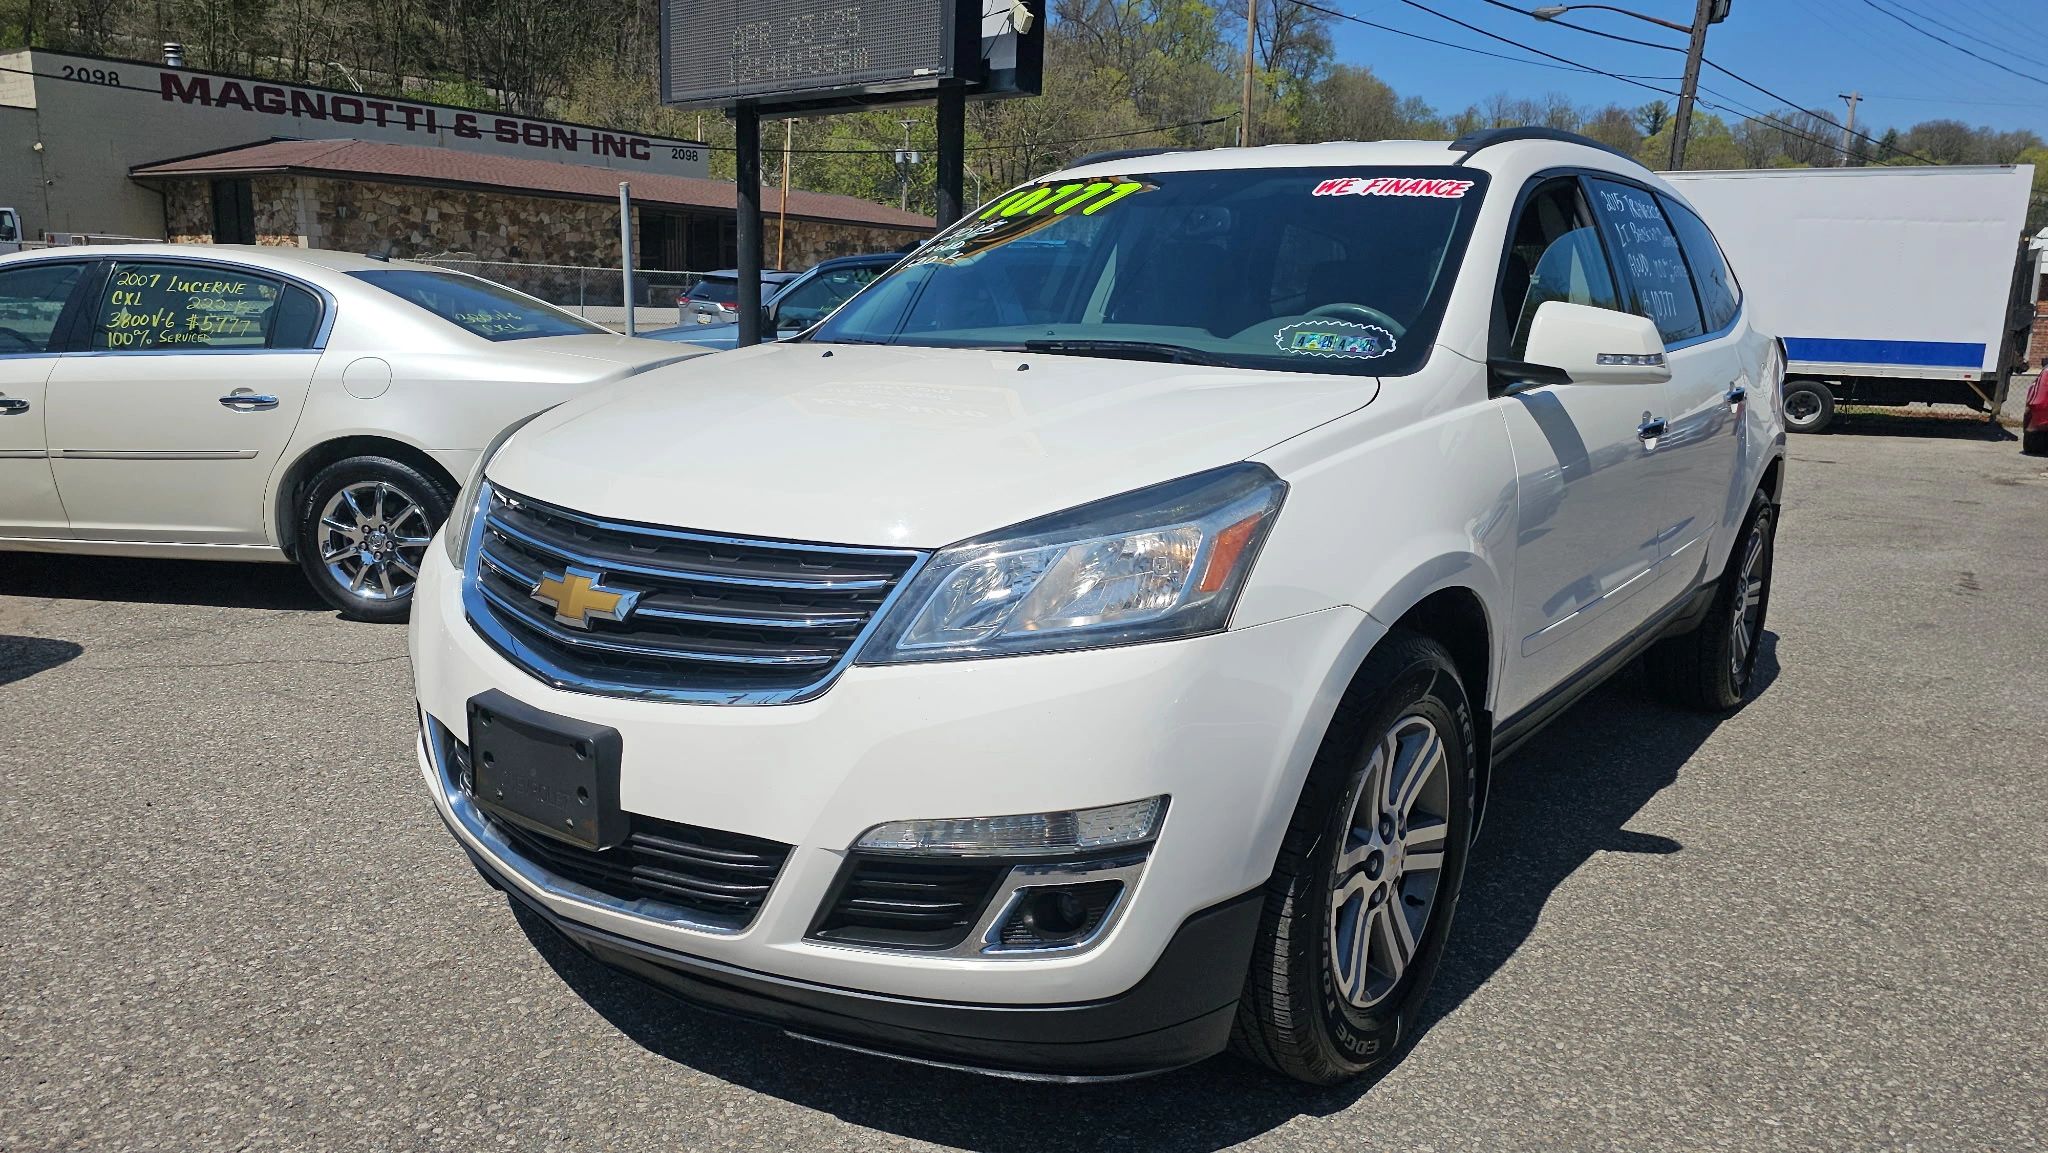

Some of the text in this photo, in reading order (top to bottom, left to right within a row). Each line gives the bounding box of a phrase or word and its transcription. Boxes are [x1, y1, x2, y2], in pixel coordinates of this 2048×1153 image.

[62, 65, 120, 86] 2098
[159, 72, 650, 160] MAGNOTTI & SON INC
[671, 148, 699, 162] 2098
[1315, 178, 1473, 197] WE FINANCE
[1600, 191, 1625, 213] 2015
[116, 271, 247, 295] 2007 LUCERNE
[111, 290, 142, 306] CXL
[106, 312, 149, 329] 3800
[107, 330, 152, 349] 100%
[1335, 1021, 1380, 1056] EDGE
